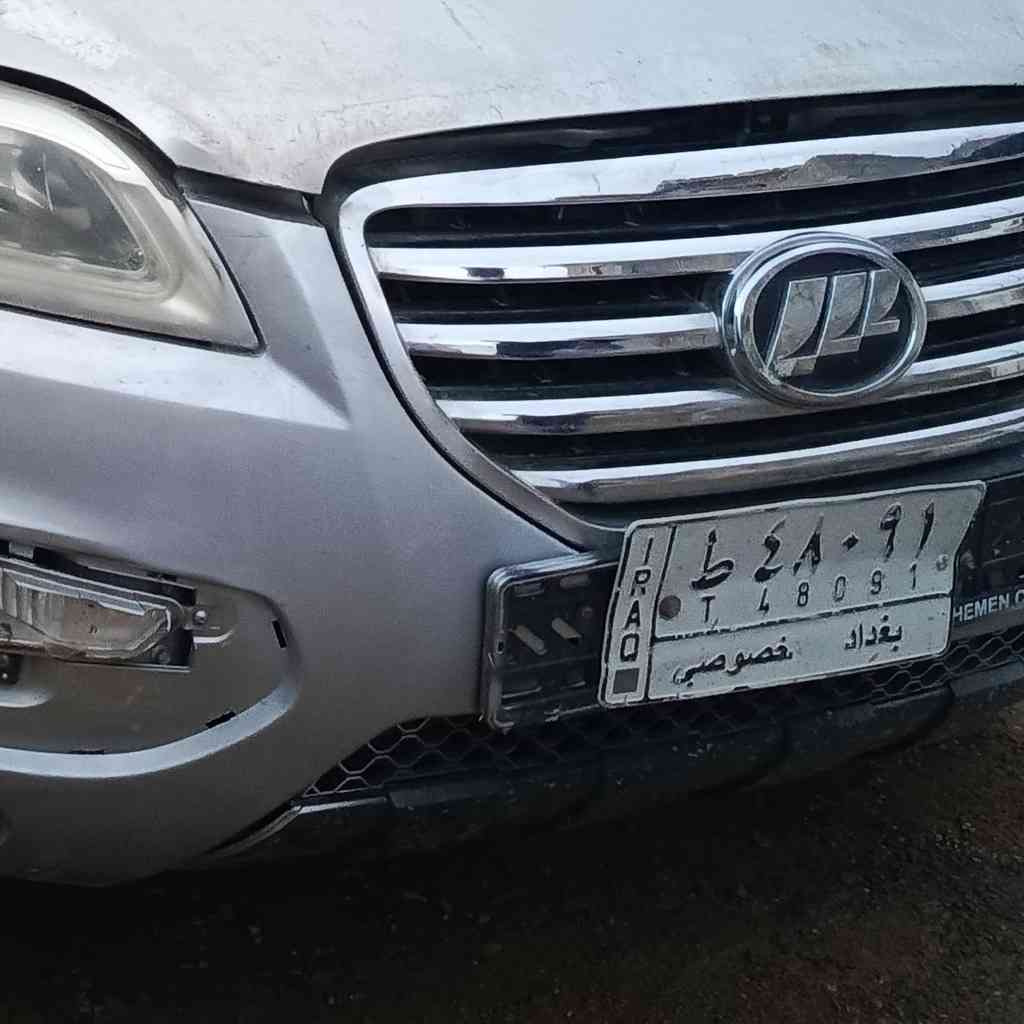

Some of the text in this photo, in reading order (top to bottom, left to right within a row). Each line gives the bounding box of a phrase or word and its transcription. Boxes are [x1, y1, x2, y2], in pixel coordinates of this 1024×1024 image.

[690, 528, 735, 590] ط
[700, 562, 918, 623] T 48091
[619, 537, 654, 662] IRAQ
[672, 614, 903, 687] بغداد خصوصي
